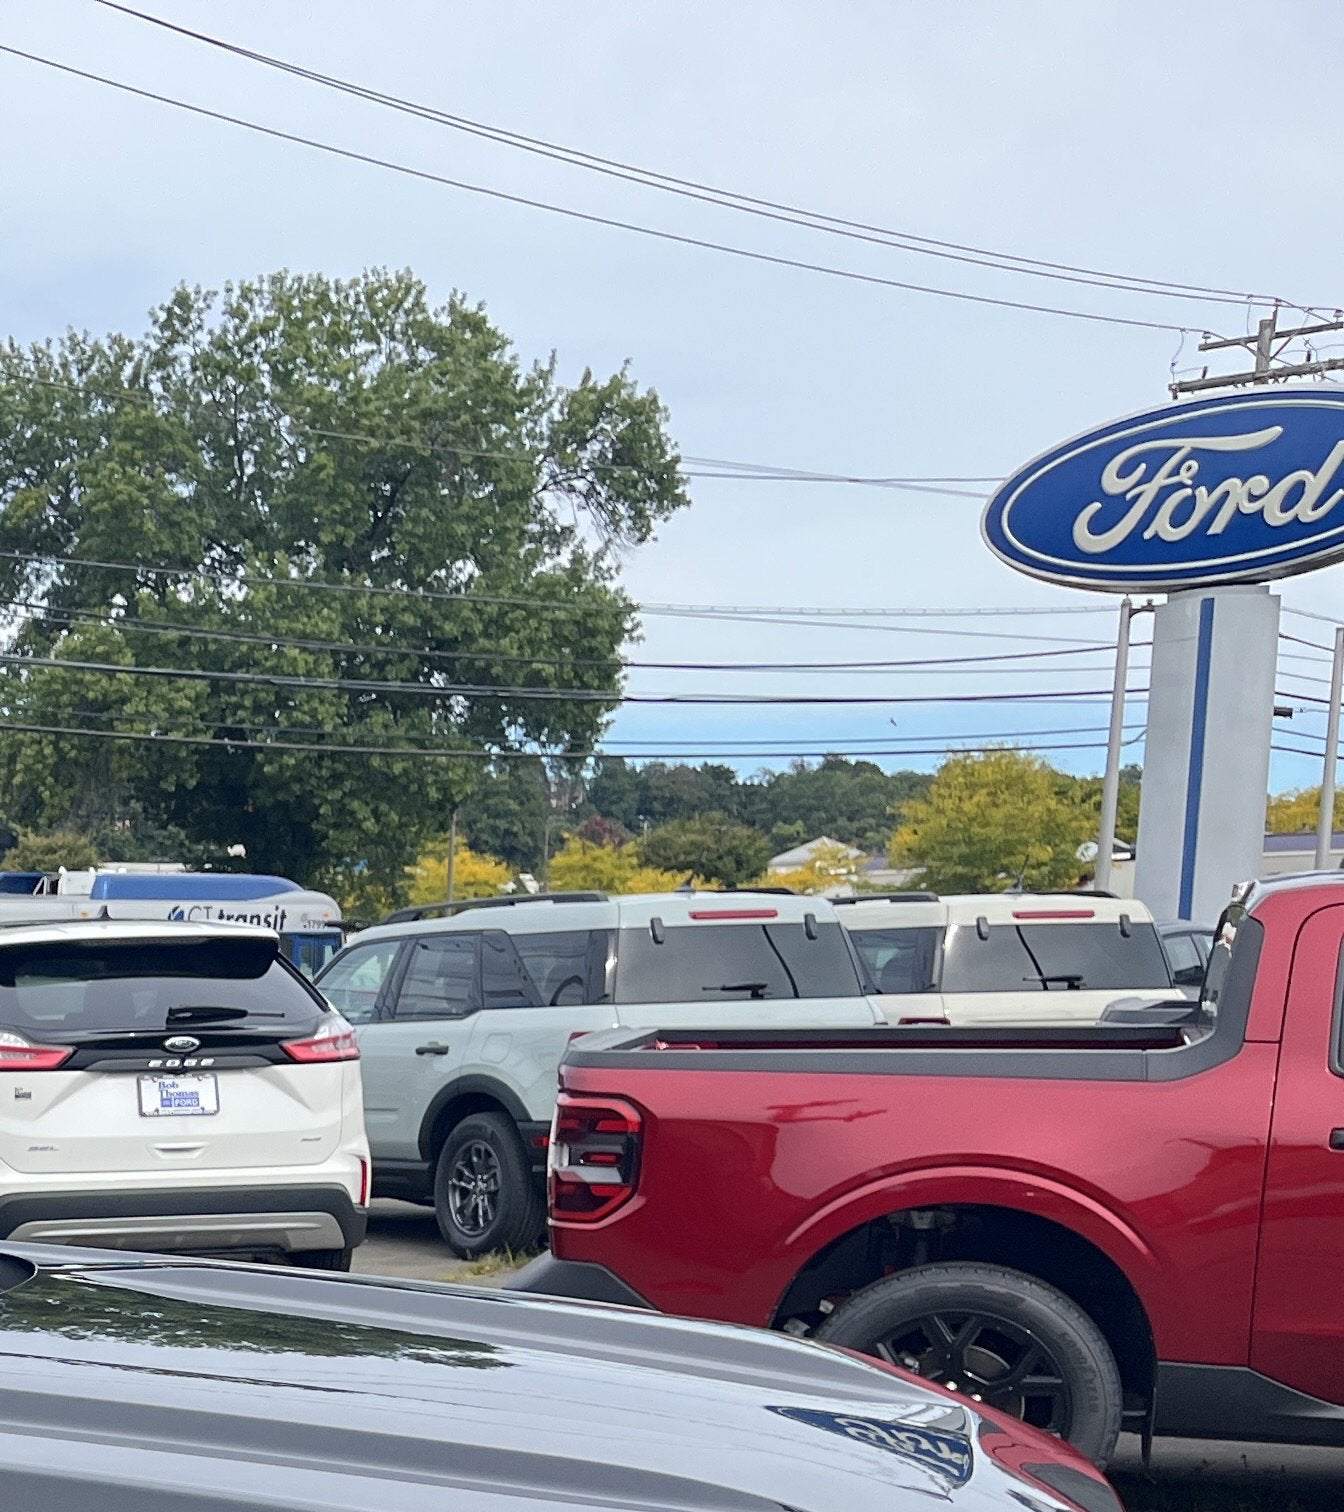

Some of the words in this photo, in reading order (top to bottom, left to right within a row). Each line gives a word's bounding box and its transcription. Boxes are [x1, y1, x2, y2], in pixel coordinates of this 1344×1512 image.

[1072, 425, 1344, 554] Ford
[217, 904, 287, 931] transit
[158, 1080, 179, 1091] Bob
[160, 1090, 200, 1099] Thomas
[174, 1098, 199, 1107] FORD
